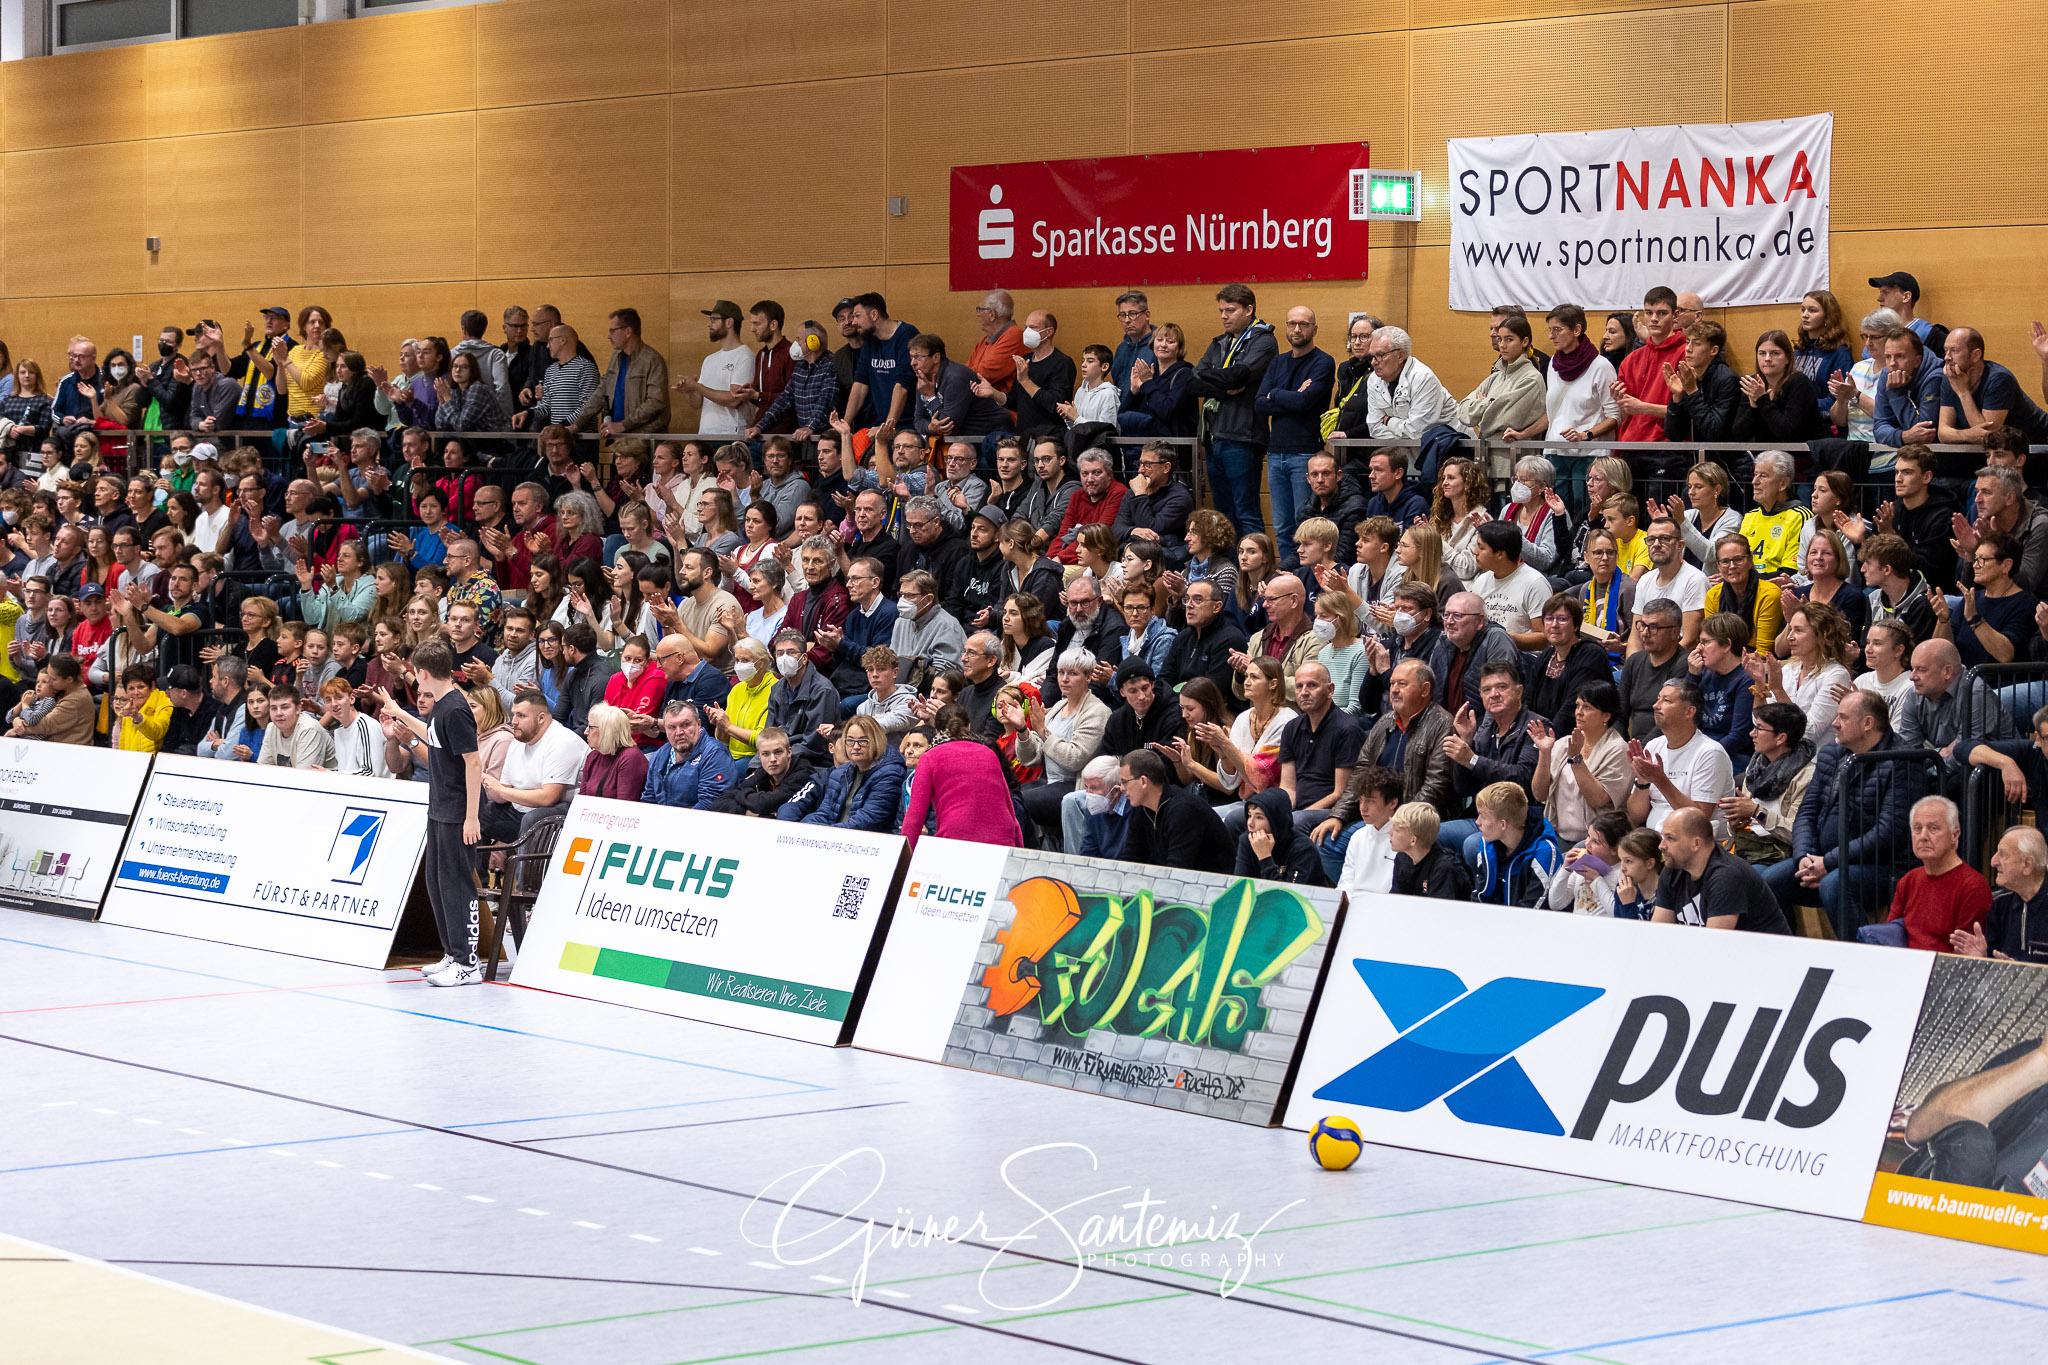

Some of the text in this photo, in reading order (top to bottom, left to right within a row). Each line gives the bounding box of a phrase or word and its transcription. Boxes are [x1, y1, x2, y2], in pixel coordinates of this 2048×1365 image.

[1031, 209, 1332, 267] Sparkasse Nürnberg
[1462, 211, 1815, 279] www.sportnanka.de
[1752, 539, 1765, 560] 4
[163, 793, 224, 816] Steuerberatung
[155, 817, 228, 842] Wirtschaftsprüfung
[579, 808, 641, 832] Firmengruppe
[147, 841, 238, 869] Unternehmensberatung
[138, 867, 221, 890] www.fuerst-beratung.de
[598, 842, 740, 899] FUCHS
[925, 884, 986, 907] FUCHS
[585, 892, 719, 938] Ideen umsetzen
[920, 905, 979, 923] Ideen umsetzen
[467, 899, 479, 964] adidas
[706, 973, 724, 993] Wir
[1570, 967, 1872, 1141] puls
[1608, 1123, 1829, 1177] MARKTFORSCHUNG
[1887, 1189, 2048, 1231] www.baumueller-s
